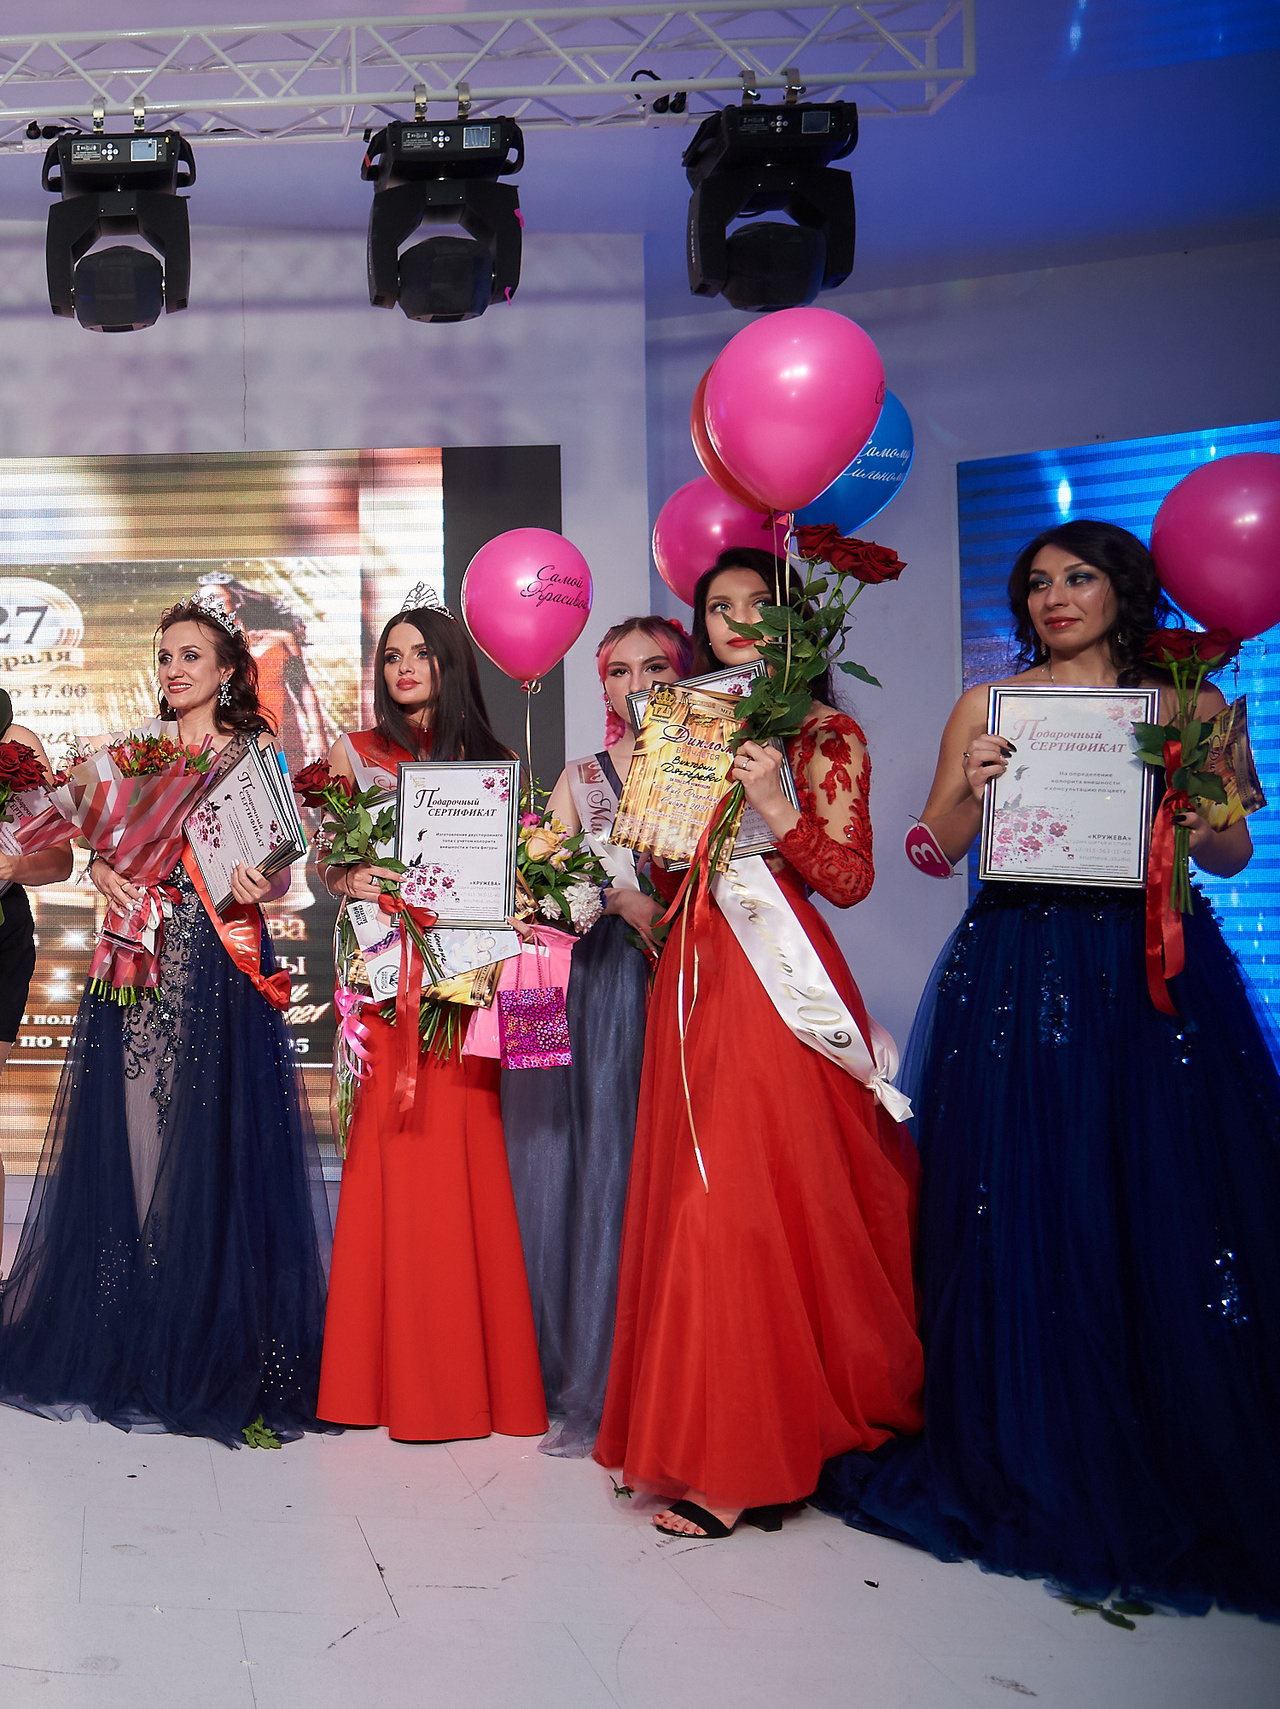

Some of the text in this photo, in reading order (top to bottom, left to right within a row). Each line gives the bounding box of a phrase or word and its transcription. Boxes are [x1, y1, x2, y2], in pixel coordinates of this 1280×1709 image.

[536, 564, 583, 589] Самой
[32, 682, 88, 699] 17.00
[1009, 716, 1102, 741] Подарочный
[675, 746, 720, 761] ВРУЧАЕТСЯ
[1030, 741, 1127, 753] СЕРТИФИКАТ
[413, 787, 481, 809] Подарочный
[239, 791, 266, 848] СЕРТИФИКАТ
[427, 807, 498, 818] СЕРТИФИКАТ
